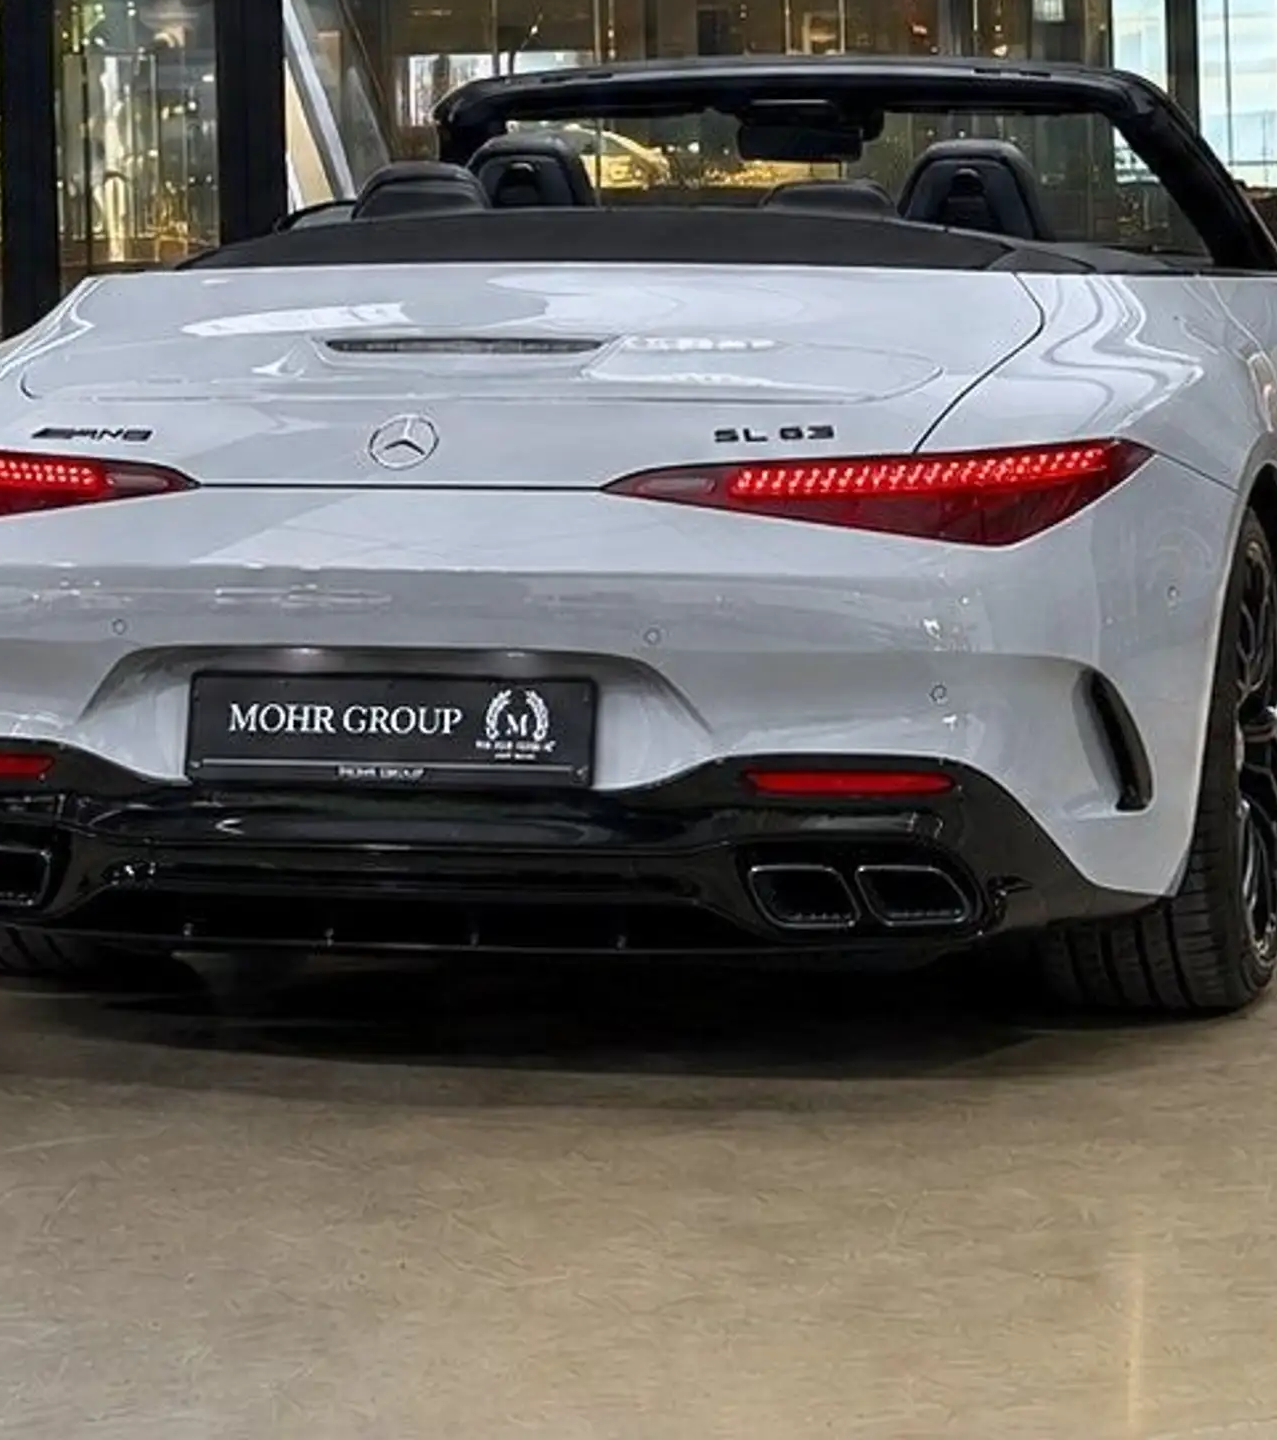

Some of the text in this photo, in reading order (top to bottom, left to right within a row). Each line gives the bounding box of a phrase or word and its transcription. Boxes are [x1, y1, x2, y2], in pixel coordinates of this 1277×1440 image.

[714, 425, 834, 443] SL 63
[228, 702, 464, 735] MOHR GROUP
